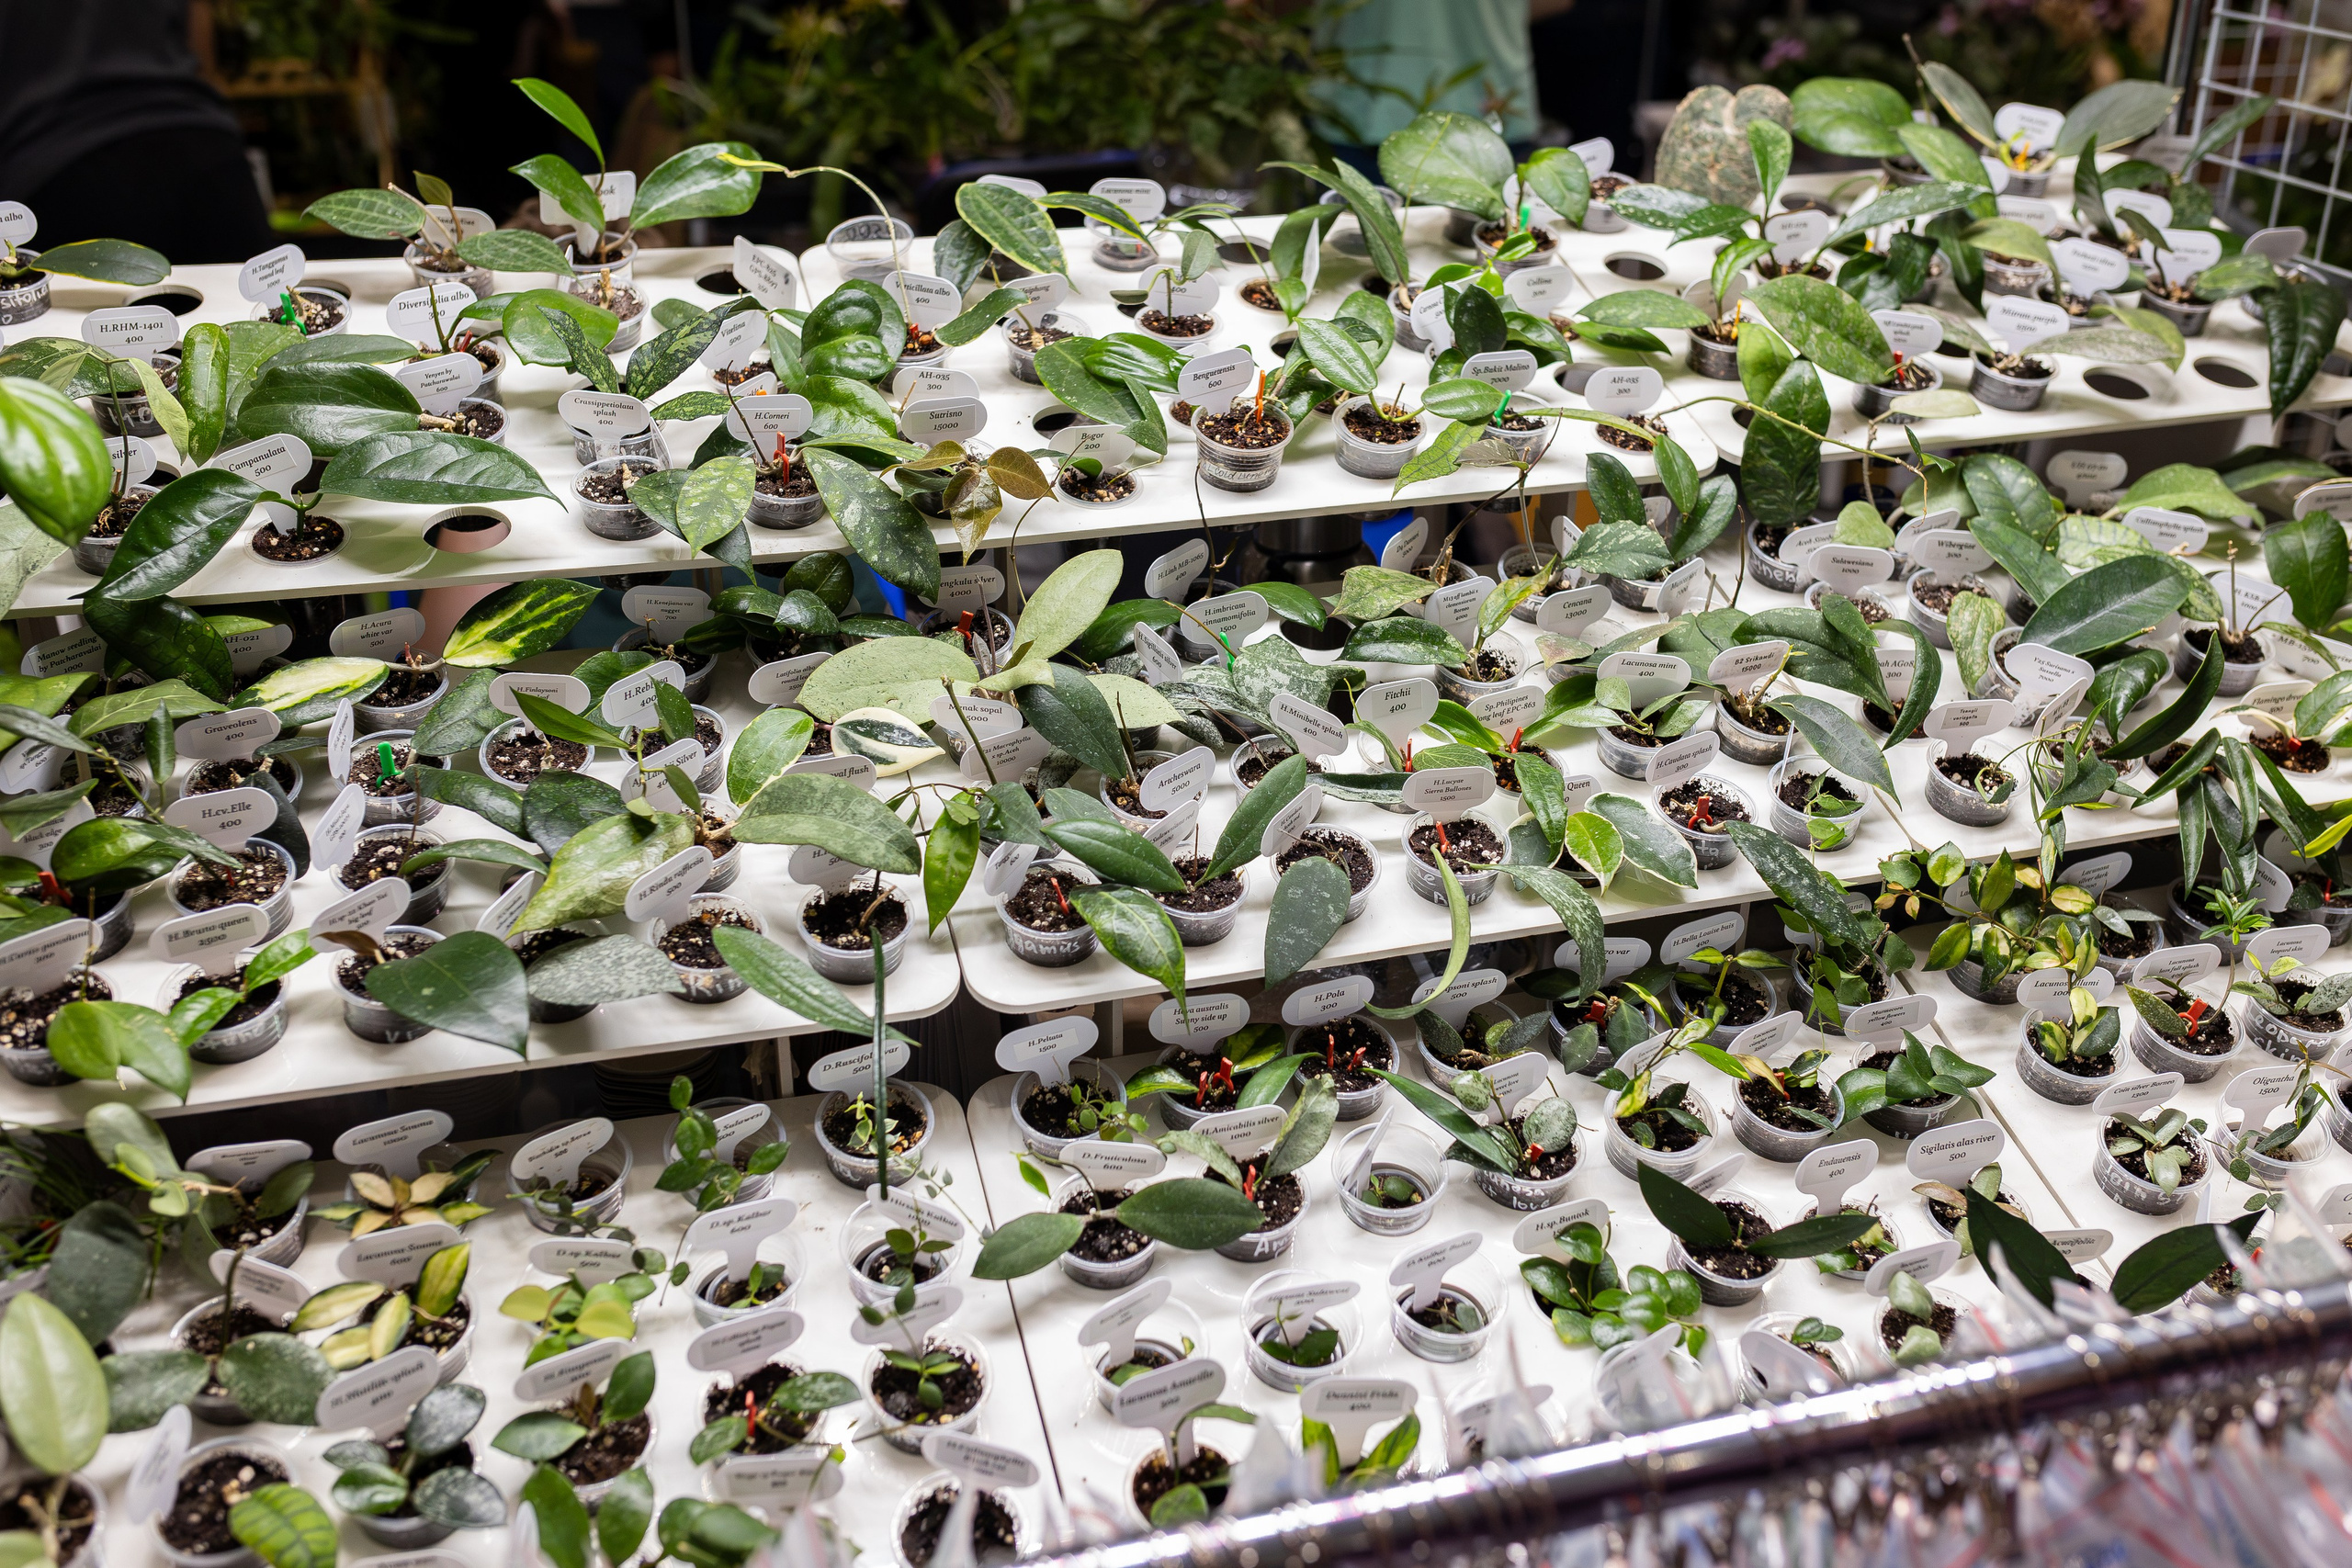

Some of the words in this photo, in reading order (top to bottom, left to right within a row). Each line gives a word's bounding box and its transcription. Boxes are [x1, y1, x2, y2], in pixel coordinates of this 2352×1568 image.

[450, 291, 469, 300] albo
[935, 286, 951, 297] albo
[100, 321, 164, 333] H.RHM-1401
[125, 334, 143, 344] 400
[729, 334, 741, 346] 500
[424, 369, 444, 379] Yenyen
[445, 367, 453, 376] by
[919, 371, 950, 381] AH-035
[1208, 379, 1222, 388] 600
[1490, 376, 1510, 385] 7000
[573, 397, 634, 412] Crassippetiolata
[593, 409, 616, 418] splash
[754, 412, 790, 421] H.Corneri
[929, 410, 963, 420] Sutrisno
[933, 422, 958, 431] 15000
[1158, 567, 1177, 581] H.Linh
[1179, 552, 1204, 570] MB-1065
[1175, 570, 1187, 581] 400
[949, 588, 971, 598] 4000
[646, 598, 683, 607] H.Kenejiana
[1204, 602, 1246, 616] H.imbricata
[1565, 609, 1588, 619] 13000
[1455, 613, 1468, 621] 4000
[360, 620, 392, 630] H.Acura
[1220, 624, 1237, 634] 1500
[223, 635, 260, 644] AH-021
[360, 630, 380, 639] white
[38, 648, 63, 662] Manow
[64, 636, 97, 653] seedling
[369, 639, 385, 648] 500
[39, 663, 48, 673] by
[64, 662, 84, 673] 1000
[1151, 656, 1162, 669] 600
[1622, 659, 1658, 670] Lacunosa
[1660, 661, 1677, 670] mint
[1741, 663, 1761, 672] 15000
[775, 667, 799, 679] Latifolia
[781, 675, 798, 684] round
[1385, 687, 1411, 701] Fitchii
[1389, 703, 1407, 714] 400
[1484, 695, 1529, 712] Sp.Philipines
[979, 705, 1001, 715] sopal
[1492, 709, 1506, 721] leaf
[1506, 701, 1536, 715] EPC-863
[966, 715, 989, 723] 5000
[1280, 704, 1320, 728] H.Minibelle
[1321, 721, 1342, 739] splash
[1499, 716, 1513, 726] 600
[205, 717, 257, 735] Graveolens
[1303, 726, 1317, 737] 400
[225, 731, 244, 741] 400
[676, 750, 697, 767] Silver
[996, 756, 1016, 766] 10000
[1656, 751, 1690, 770] H.Caudata
[1691, 744, 1713, 760] splash
[848, 765, 869, 778] flush
[1675, 762, 1688, 773] 300
[1170, 780, 1190, 795] 5000
[1424, 786, 1443, 795] Sierra
[1566, 781, 1590, 793] Queen
[201, 802, 253, 819] H.cv.Elle
[219, 818, 242, 829] 400
[639, 868, 673, 901] H.Rinda
[666, 881, 682, 897] 500
[1673, 933, 1698, 947] H.Bella
[1699, 928, 1720, 939] Louise
[1721, 922, 1735, 934] buis
[1695, 940, 1709, 948] 400
[1471, 976, 1498, 989] splash
[1314, 989, 1345, 1002] H.Pola
[1451, 991, 1467, 1000] 500
[1195, 1002, 1229, 1014] australis
[1320, 1002, 1338, 1012] 300
[1202, 1013, 1216, 1022] side
[1217, 1013, 1227, 1023] up
[1193, 1025, 1209, 1033] 500
[1028, 1032, 1063, 1047] H.Peltata
[884, 1045, 899, 1055] var
[1039, 1043, 1057, 1054] 1500
[853, 1064, 871, 1075] 500
[2253, 1074, 2295, 1087] Oligantha
[2114, 1087, 2129, 1095] Coin
[2130, 1083, 2150, 1093] silver
[2150, 1079, 2176, 1089] Borneo
[2258, 1087, 2280, 1096] 1500
[1201, 1122, 1255, 1137] H.Amicabilis
[1256, 1115, 1279, 1127] silver
[1229, 1131, 1250, 1140] 1000
[1920, 1142, 1955, 1155] Sigilatis
[1956, 1138, 1974, 1147] alas
[1975, 1134, 1996, 1145] river
[1949, 1151, 1966, 1161] 500
[1828, 1168, 1845, 1179] 400
